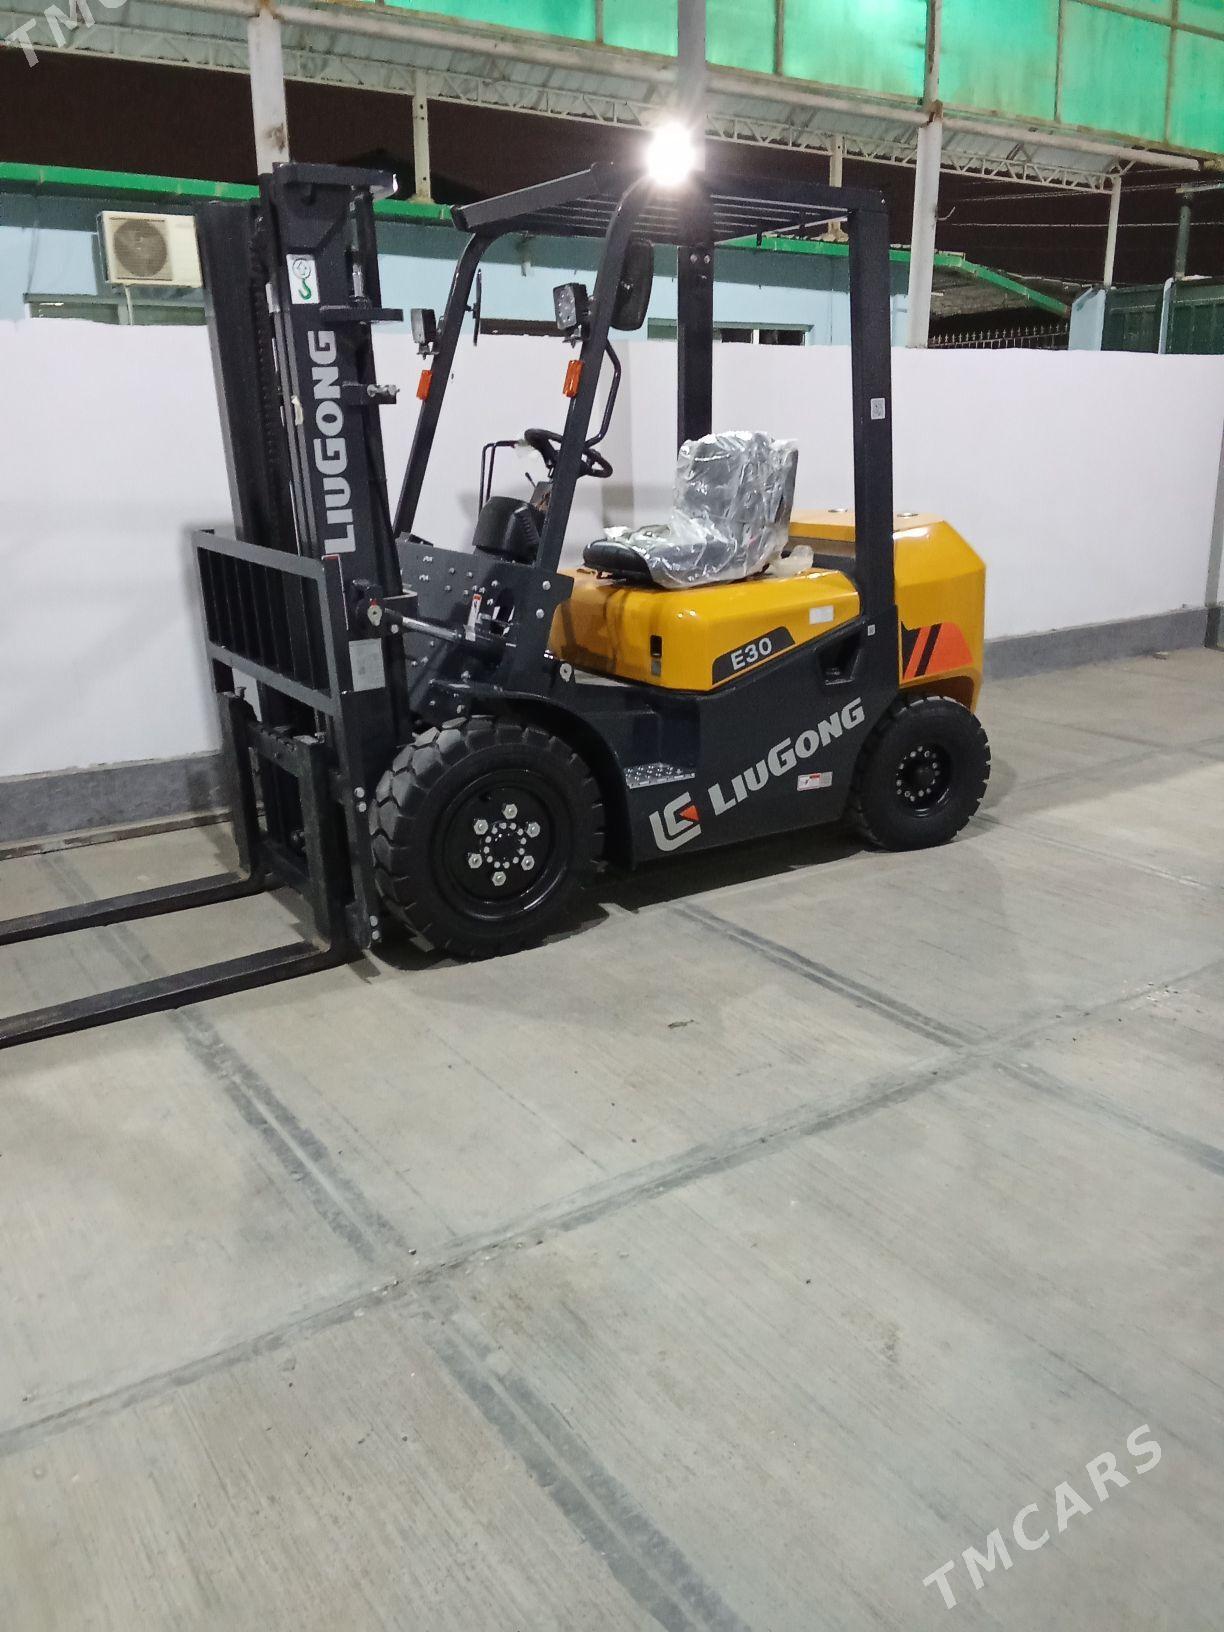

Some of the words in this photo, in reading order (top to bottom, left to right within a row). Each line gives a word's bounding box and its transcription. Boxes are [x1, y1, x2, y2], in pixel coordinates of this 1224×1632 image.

[307, 330, 356, 555] LIUGONG
[730, 637, 772, 671] E30
[708, 697, 866, 816] LIUGONG
